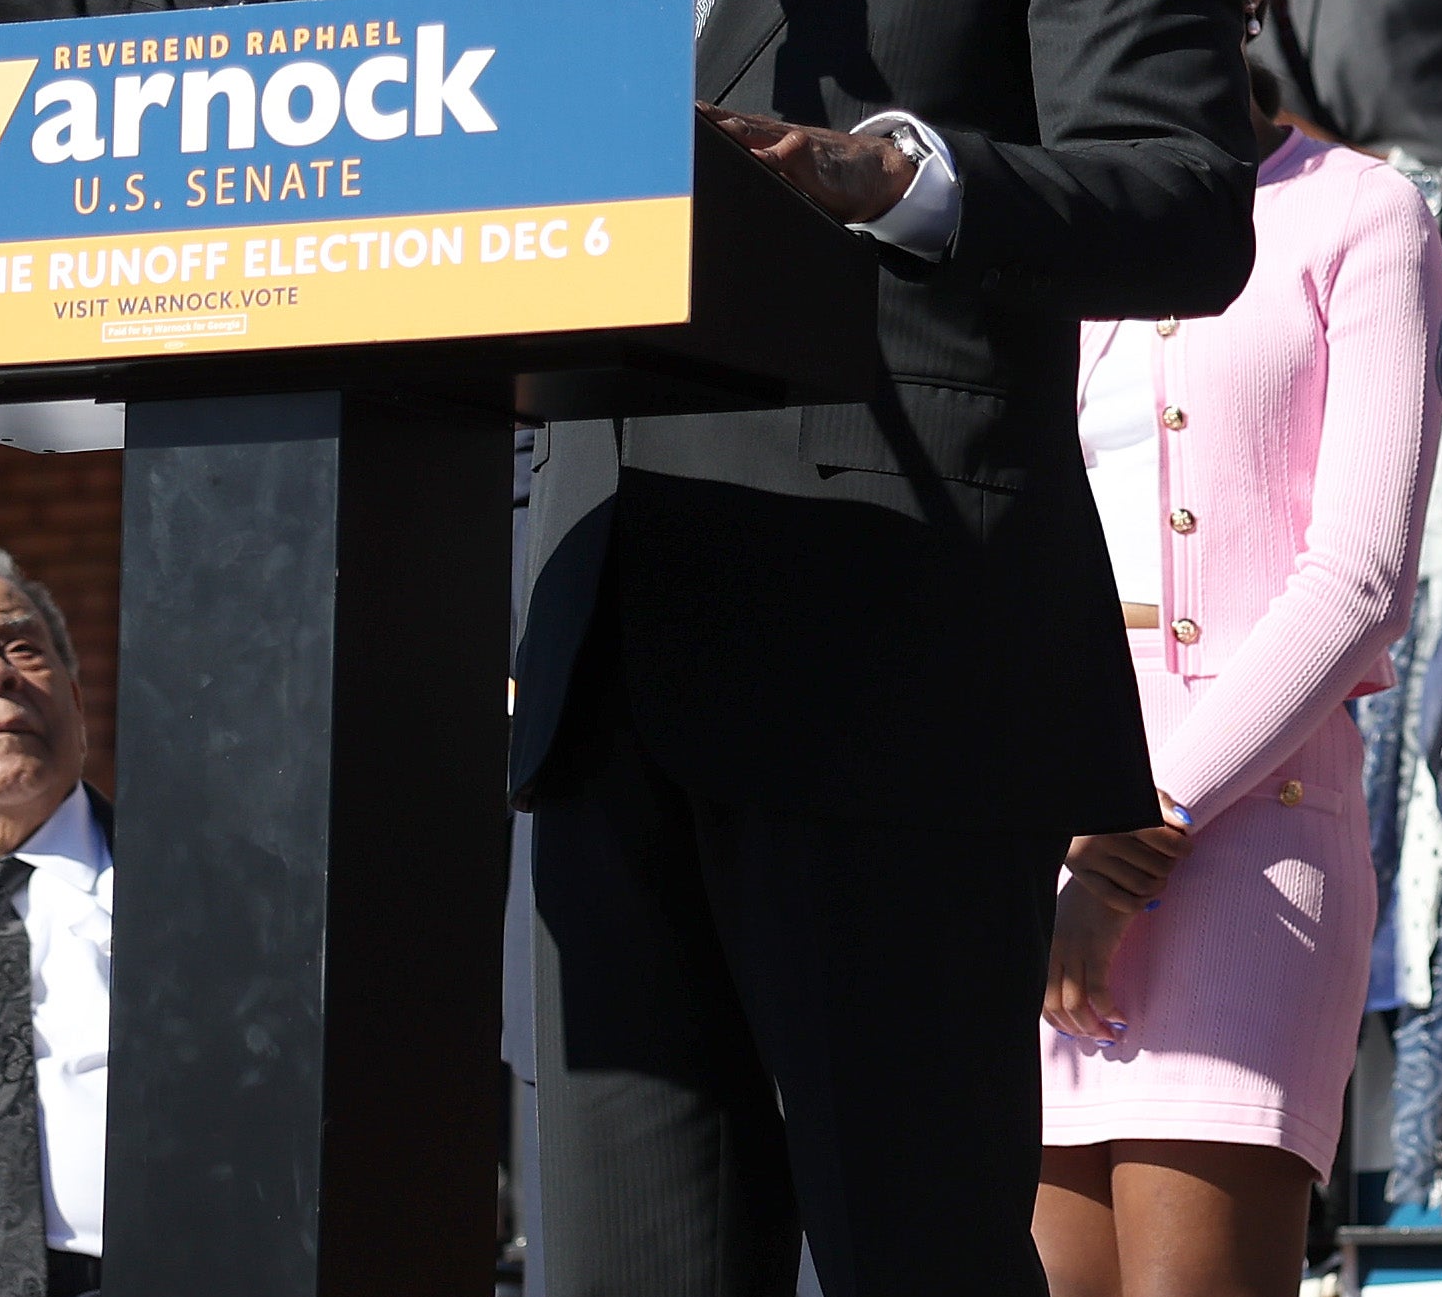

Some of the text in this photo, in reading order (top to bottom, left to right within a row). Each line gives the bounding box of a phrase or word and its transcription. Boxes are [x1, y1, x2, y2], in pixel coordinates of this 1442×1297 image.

[55, 21, 401, 70] REVEREND RAPHAEL
[74, 158, 361, 214] U.S. SENATE
[48, 241, 228, 291] RUNOFF
[244, 226, 463, 278] ELECTION
[480, 219, 568, 263] DEC
[584, 217, 610, 257] 6
[53, 286, 299, 320] VISIT WARNOCK.VOTE
[108, 327, 127, 336] Paid
[154, 322, 192, 334] Warnock
[207, 319, 241, 332] Georgia
